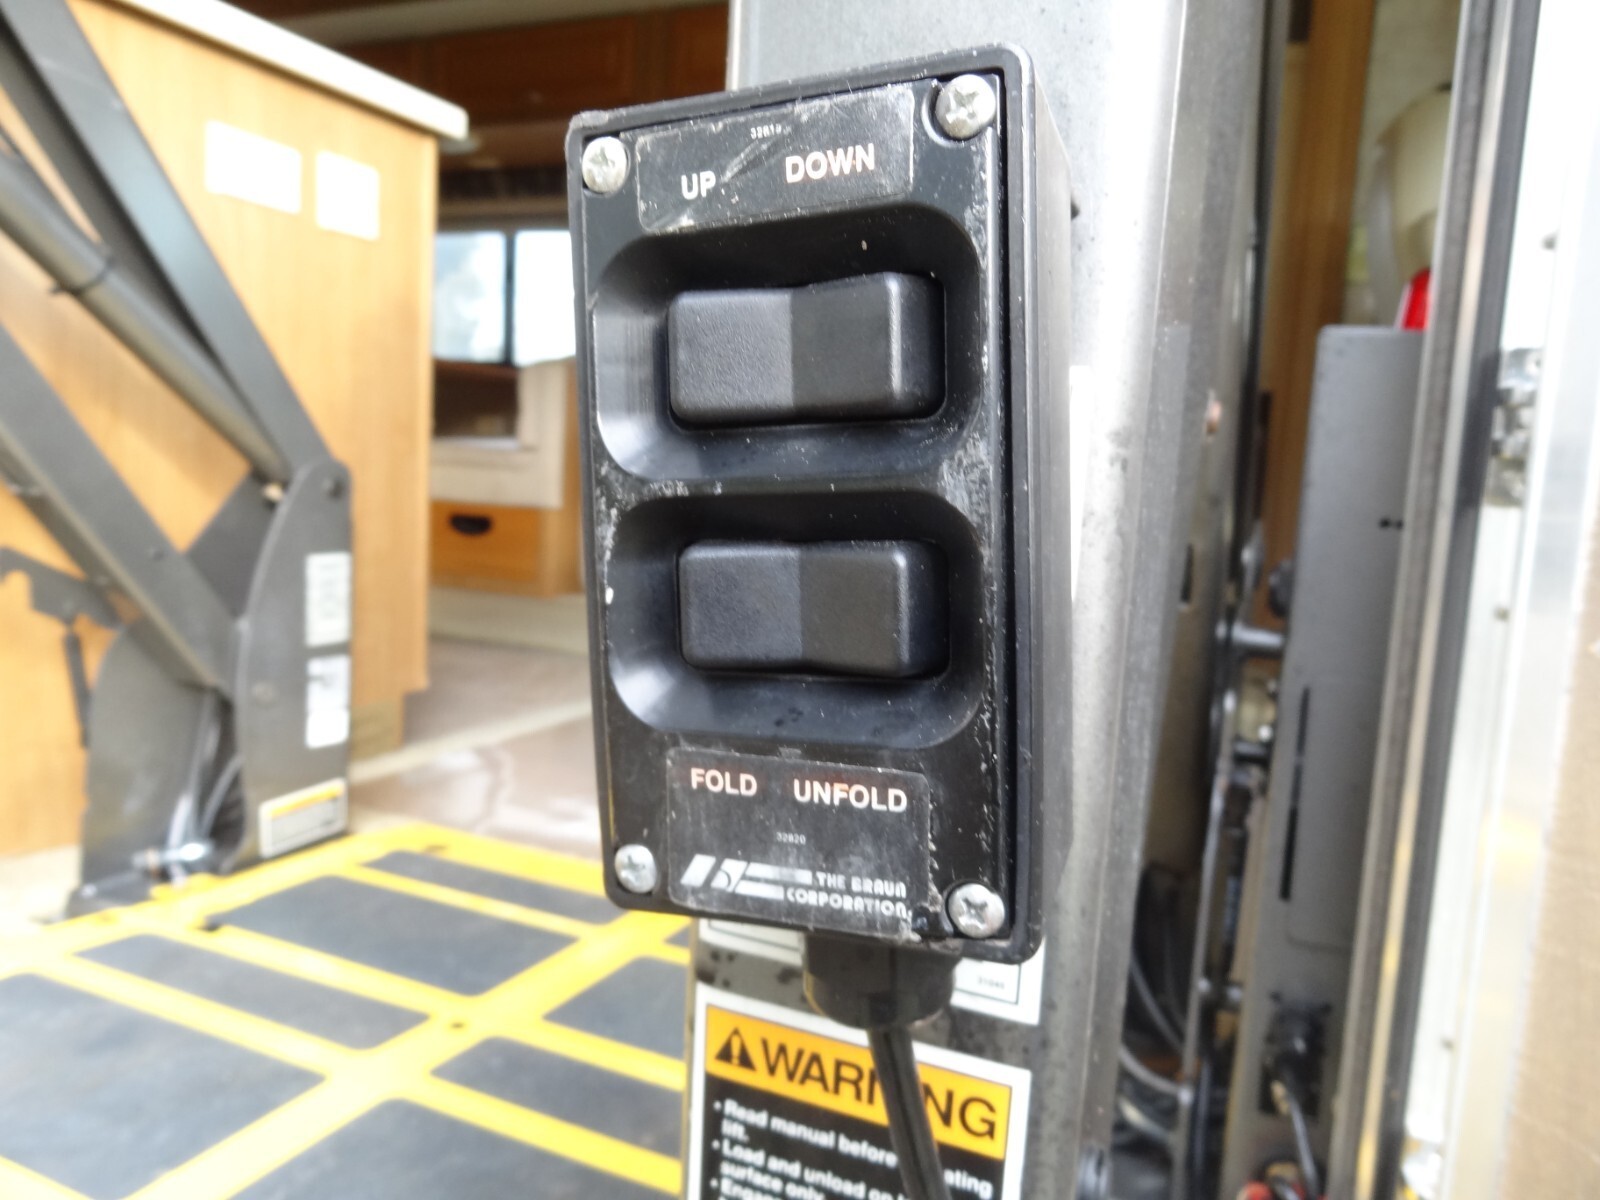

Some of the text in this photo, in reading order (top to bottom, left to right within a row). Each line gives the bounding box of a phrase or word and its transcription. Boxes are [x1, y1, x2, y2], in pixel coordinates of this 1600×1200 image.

[681, 143, 875, 199] UP DOWN
[691, 767, 908, 813] FOLD UNFOLD
[787, 886, 908, 919] CORPORATION
[816, 871, 907, 899] THE BRAUN
[761, 1037, 997, 1140] WARNG
[721, 1117, 749, 1143] lift.
[724, 1099, 769, 1127] Read
[770, 1116, 836, 1149] manual
[838, 1133, 899, 1168] before
[720, 1160, 784, 1193] surface
[722, 1138, 766, 1167] Load
[767, 1155, 801, 1179] and
[803, 1167, 867, 1200] unload
